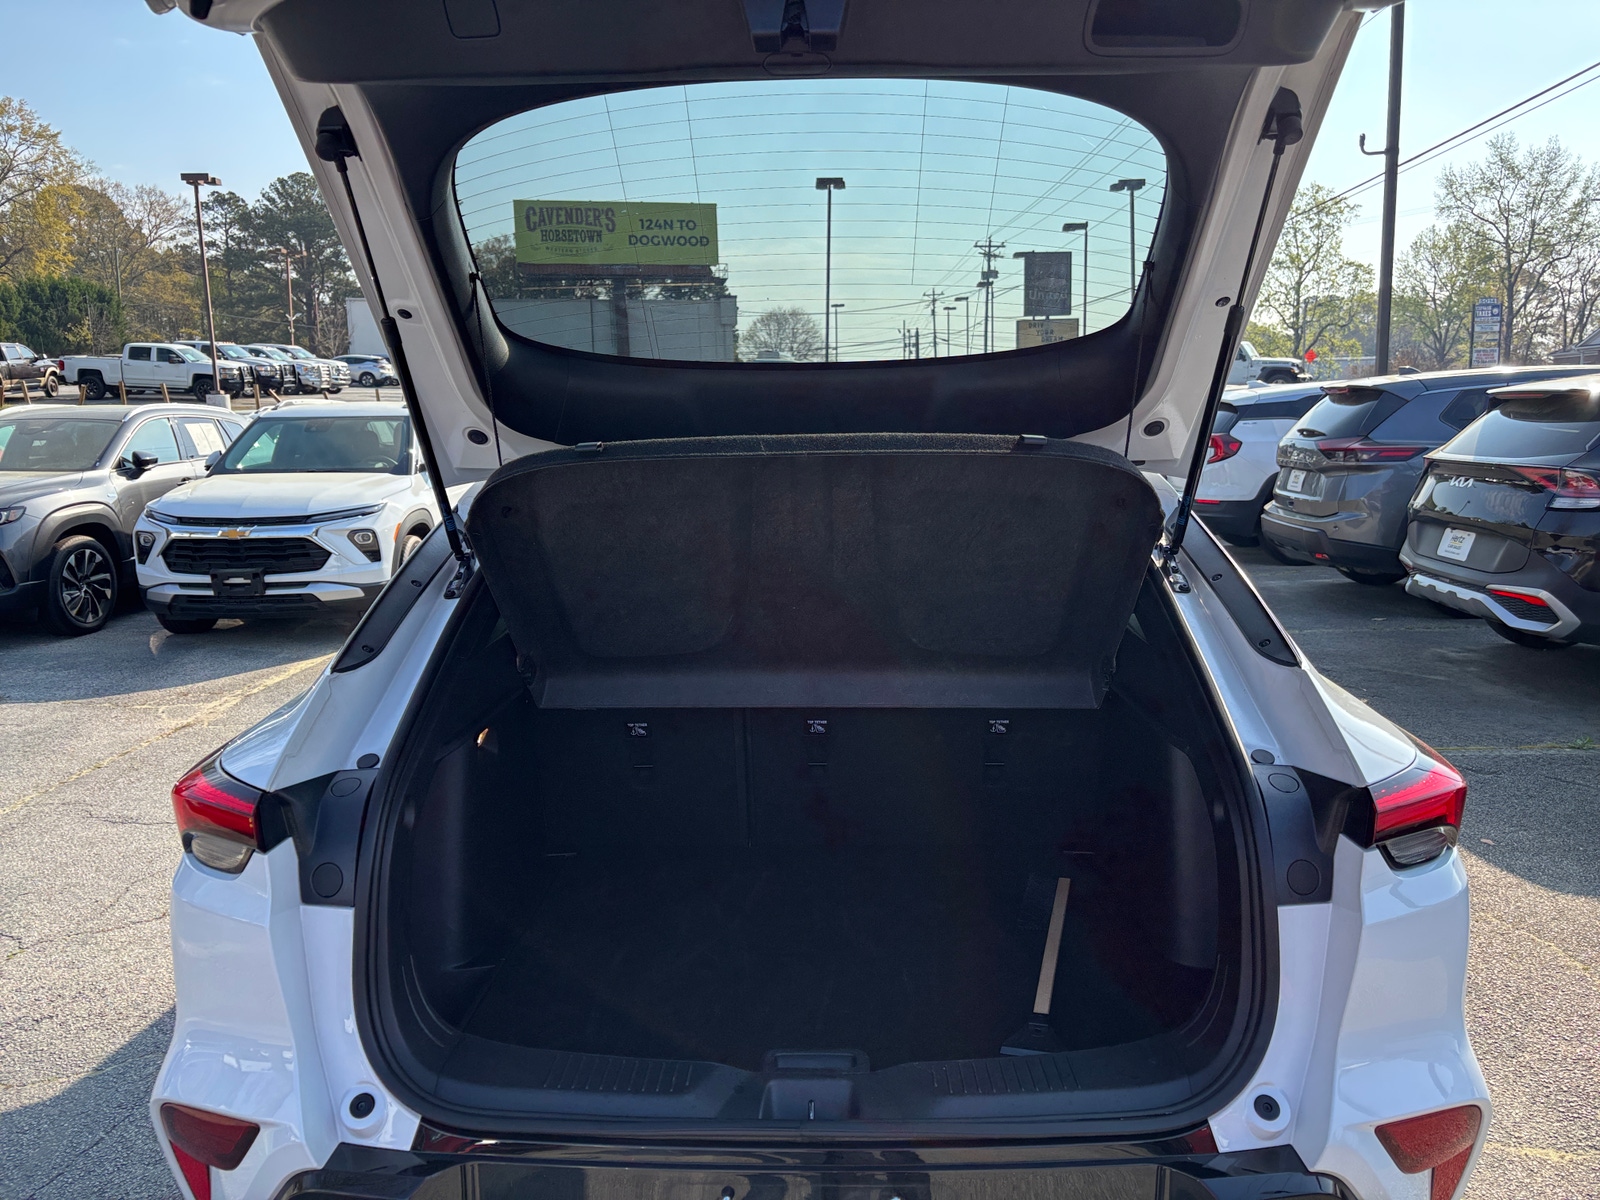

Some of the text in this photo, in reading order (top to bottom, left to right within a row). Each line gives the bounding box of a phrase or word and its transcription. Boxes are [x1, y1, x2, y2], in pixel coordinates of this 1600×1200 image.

[525, 206, 616, 233] CAVENDER'S
[639, 218, 697, 231] 124N TO
[540, 229, 603, 244] HORSETOWN
[628, 235, 710, 247] DOGWOOD
[1450, 476, 1474, 488] KIA
[1451, 534, 1466, 544] Hertz
